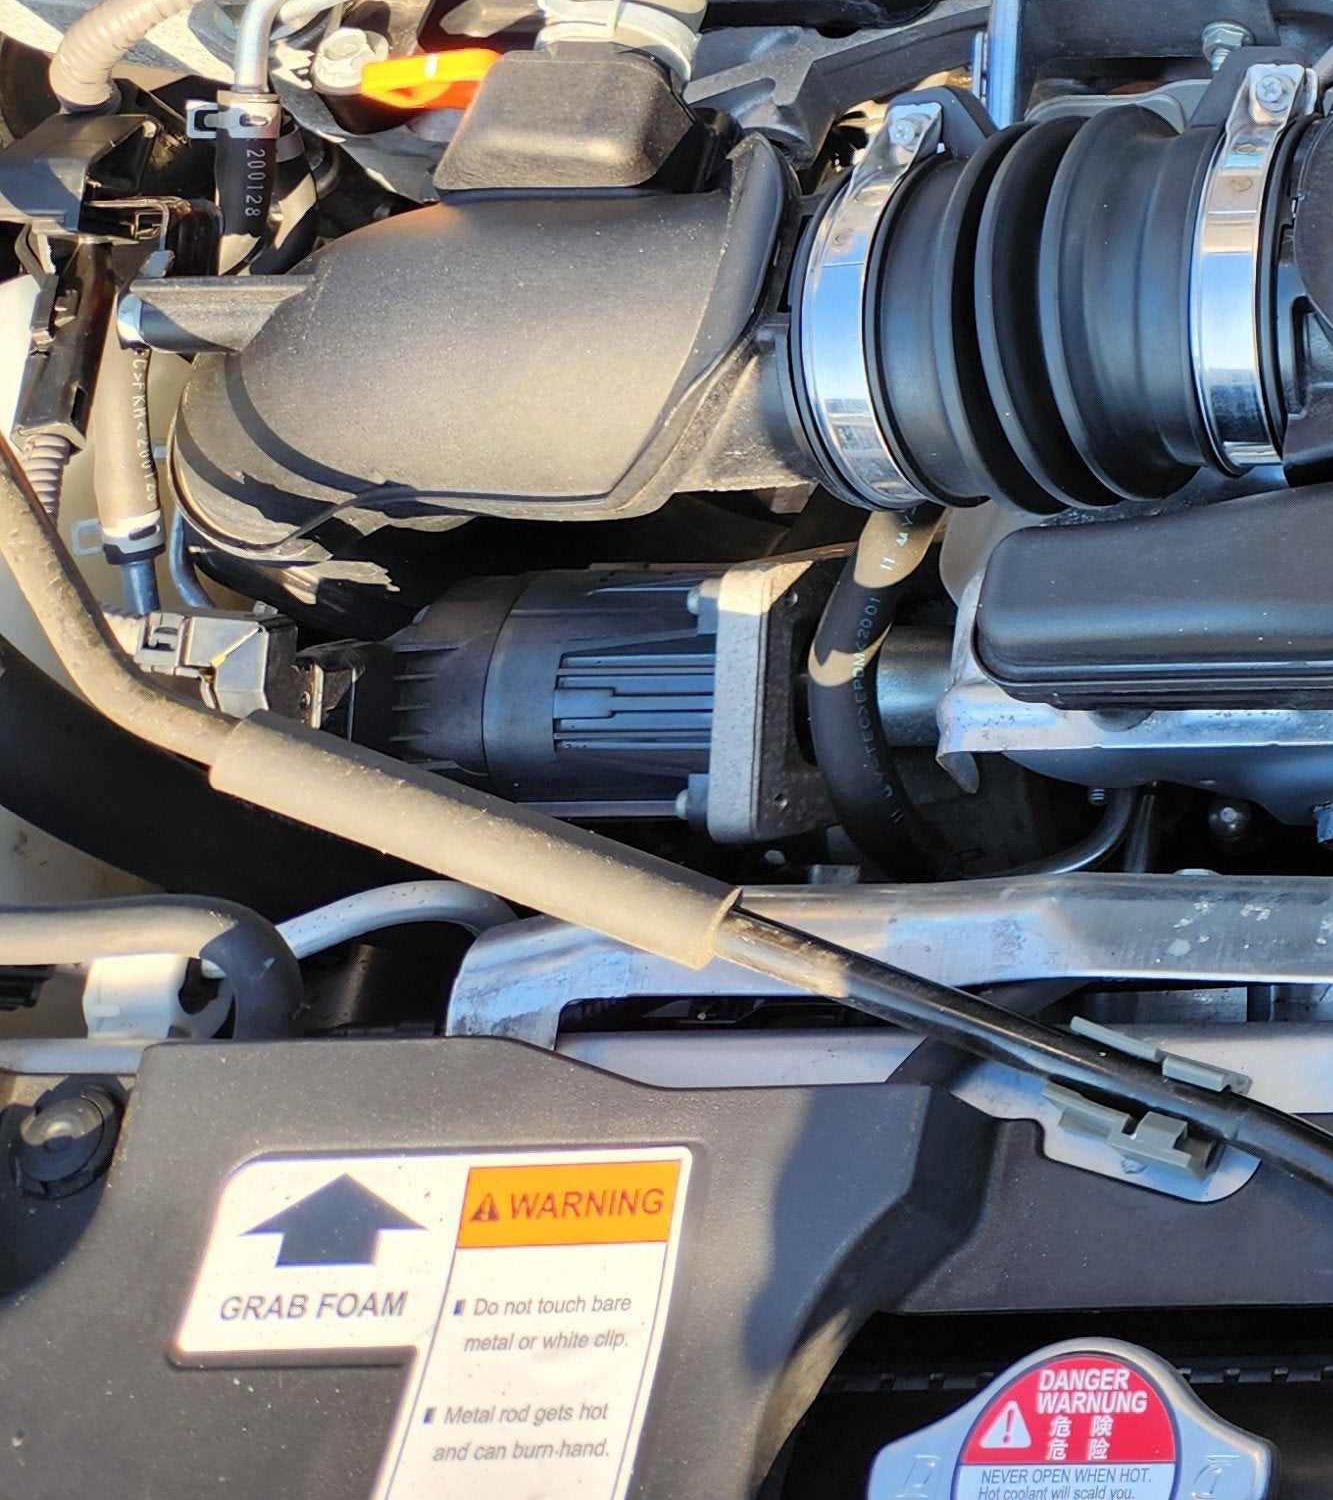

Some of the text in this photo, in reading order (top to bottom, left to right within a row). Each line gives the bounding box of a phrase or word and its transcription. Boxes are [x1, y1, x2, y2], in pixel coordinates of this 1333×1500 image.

[244, 148, 267, 217] 200128
[509, 1187, 665, 1221] WARNING
[220, 1290, 409, 1322] GRAB FOAM
[473, 1294, 632, 1317] Do not touch bare
[463, 1330, 629, 1353] metal or white clip.
[1037, 1369, 1131, 1391] DANGER
[1035, 1391, 1148, 1415] WARNUNG
[443, 1403, 609, 1428] Metal rod gets hot
[433, 1439, 610, 1462] and can burn hand.
[981, 1467, 1152, 1485] NEVER OPEN WHEN HOT.
[978, 1485, 1002, 1500] Hot
[1003, 1486, 1049, 1500] coolant
[1051, 1485, 1071, 1500] will
[1073, 1484, 1108, 1500] scald
